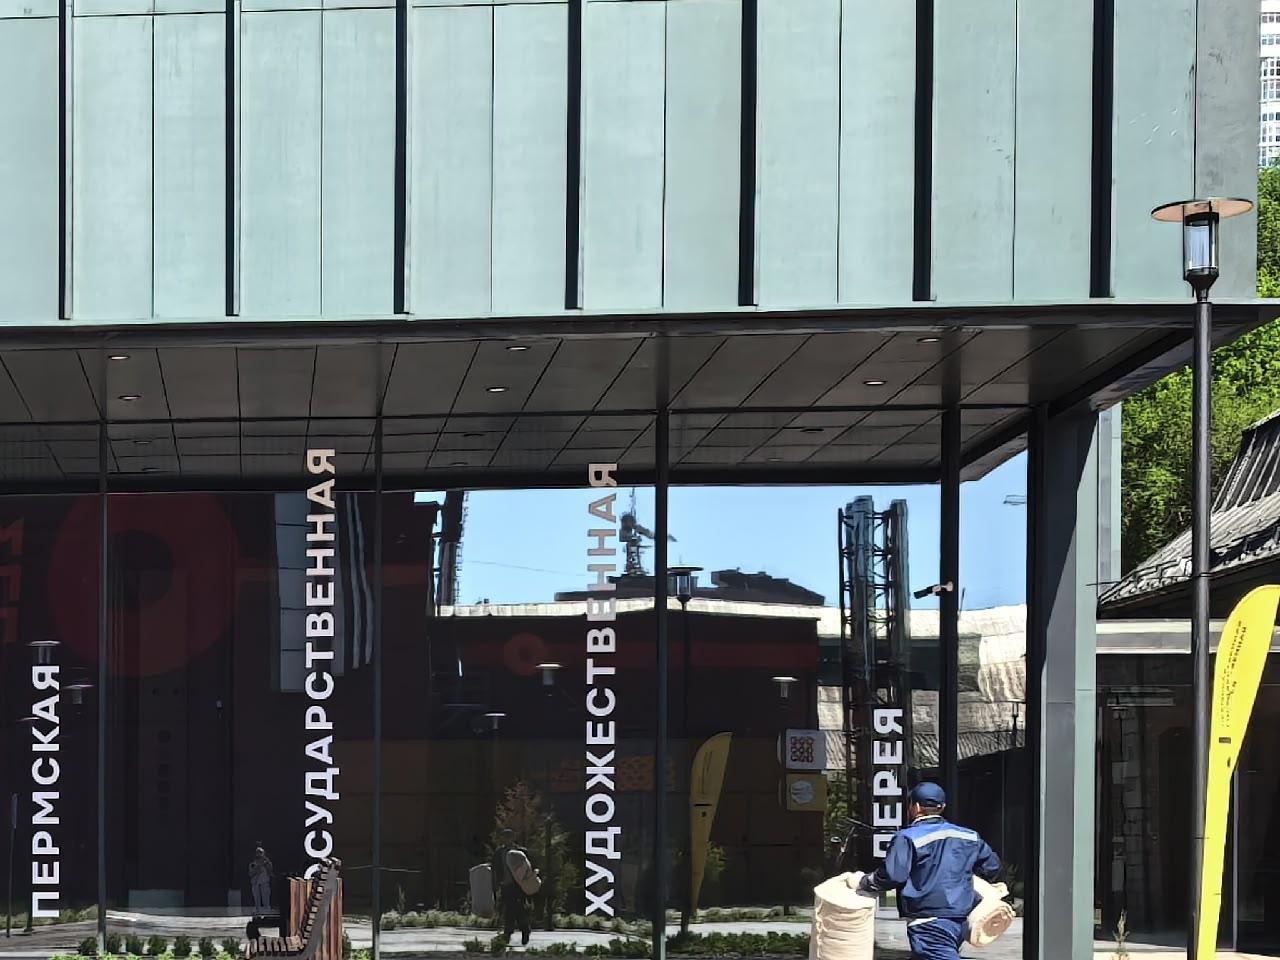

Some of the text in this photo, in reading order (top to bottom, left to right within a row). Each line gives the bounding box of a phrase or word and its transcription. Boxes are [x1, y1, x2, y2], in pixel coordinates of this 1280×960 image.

[31, 665, 61, 919] ПЕРМСКАЯ
[304, 449, 340, 879] СУДАРСТВЕННАЯ
[585, 463, 621, 917] ХУДОЖЕСТВЕННАЯ
